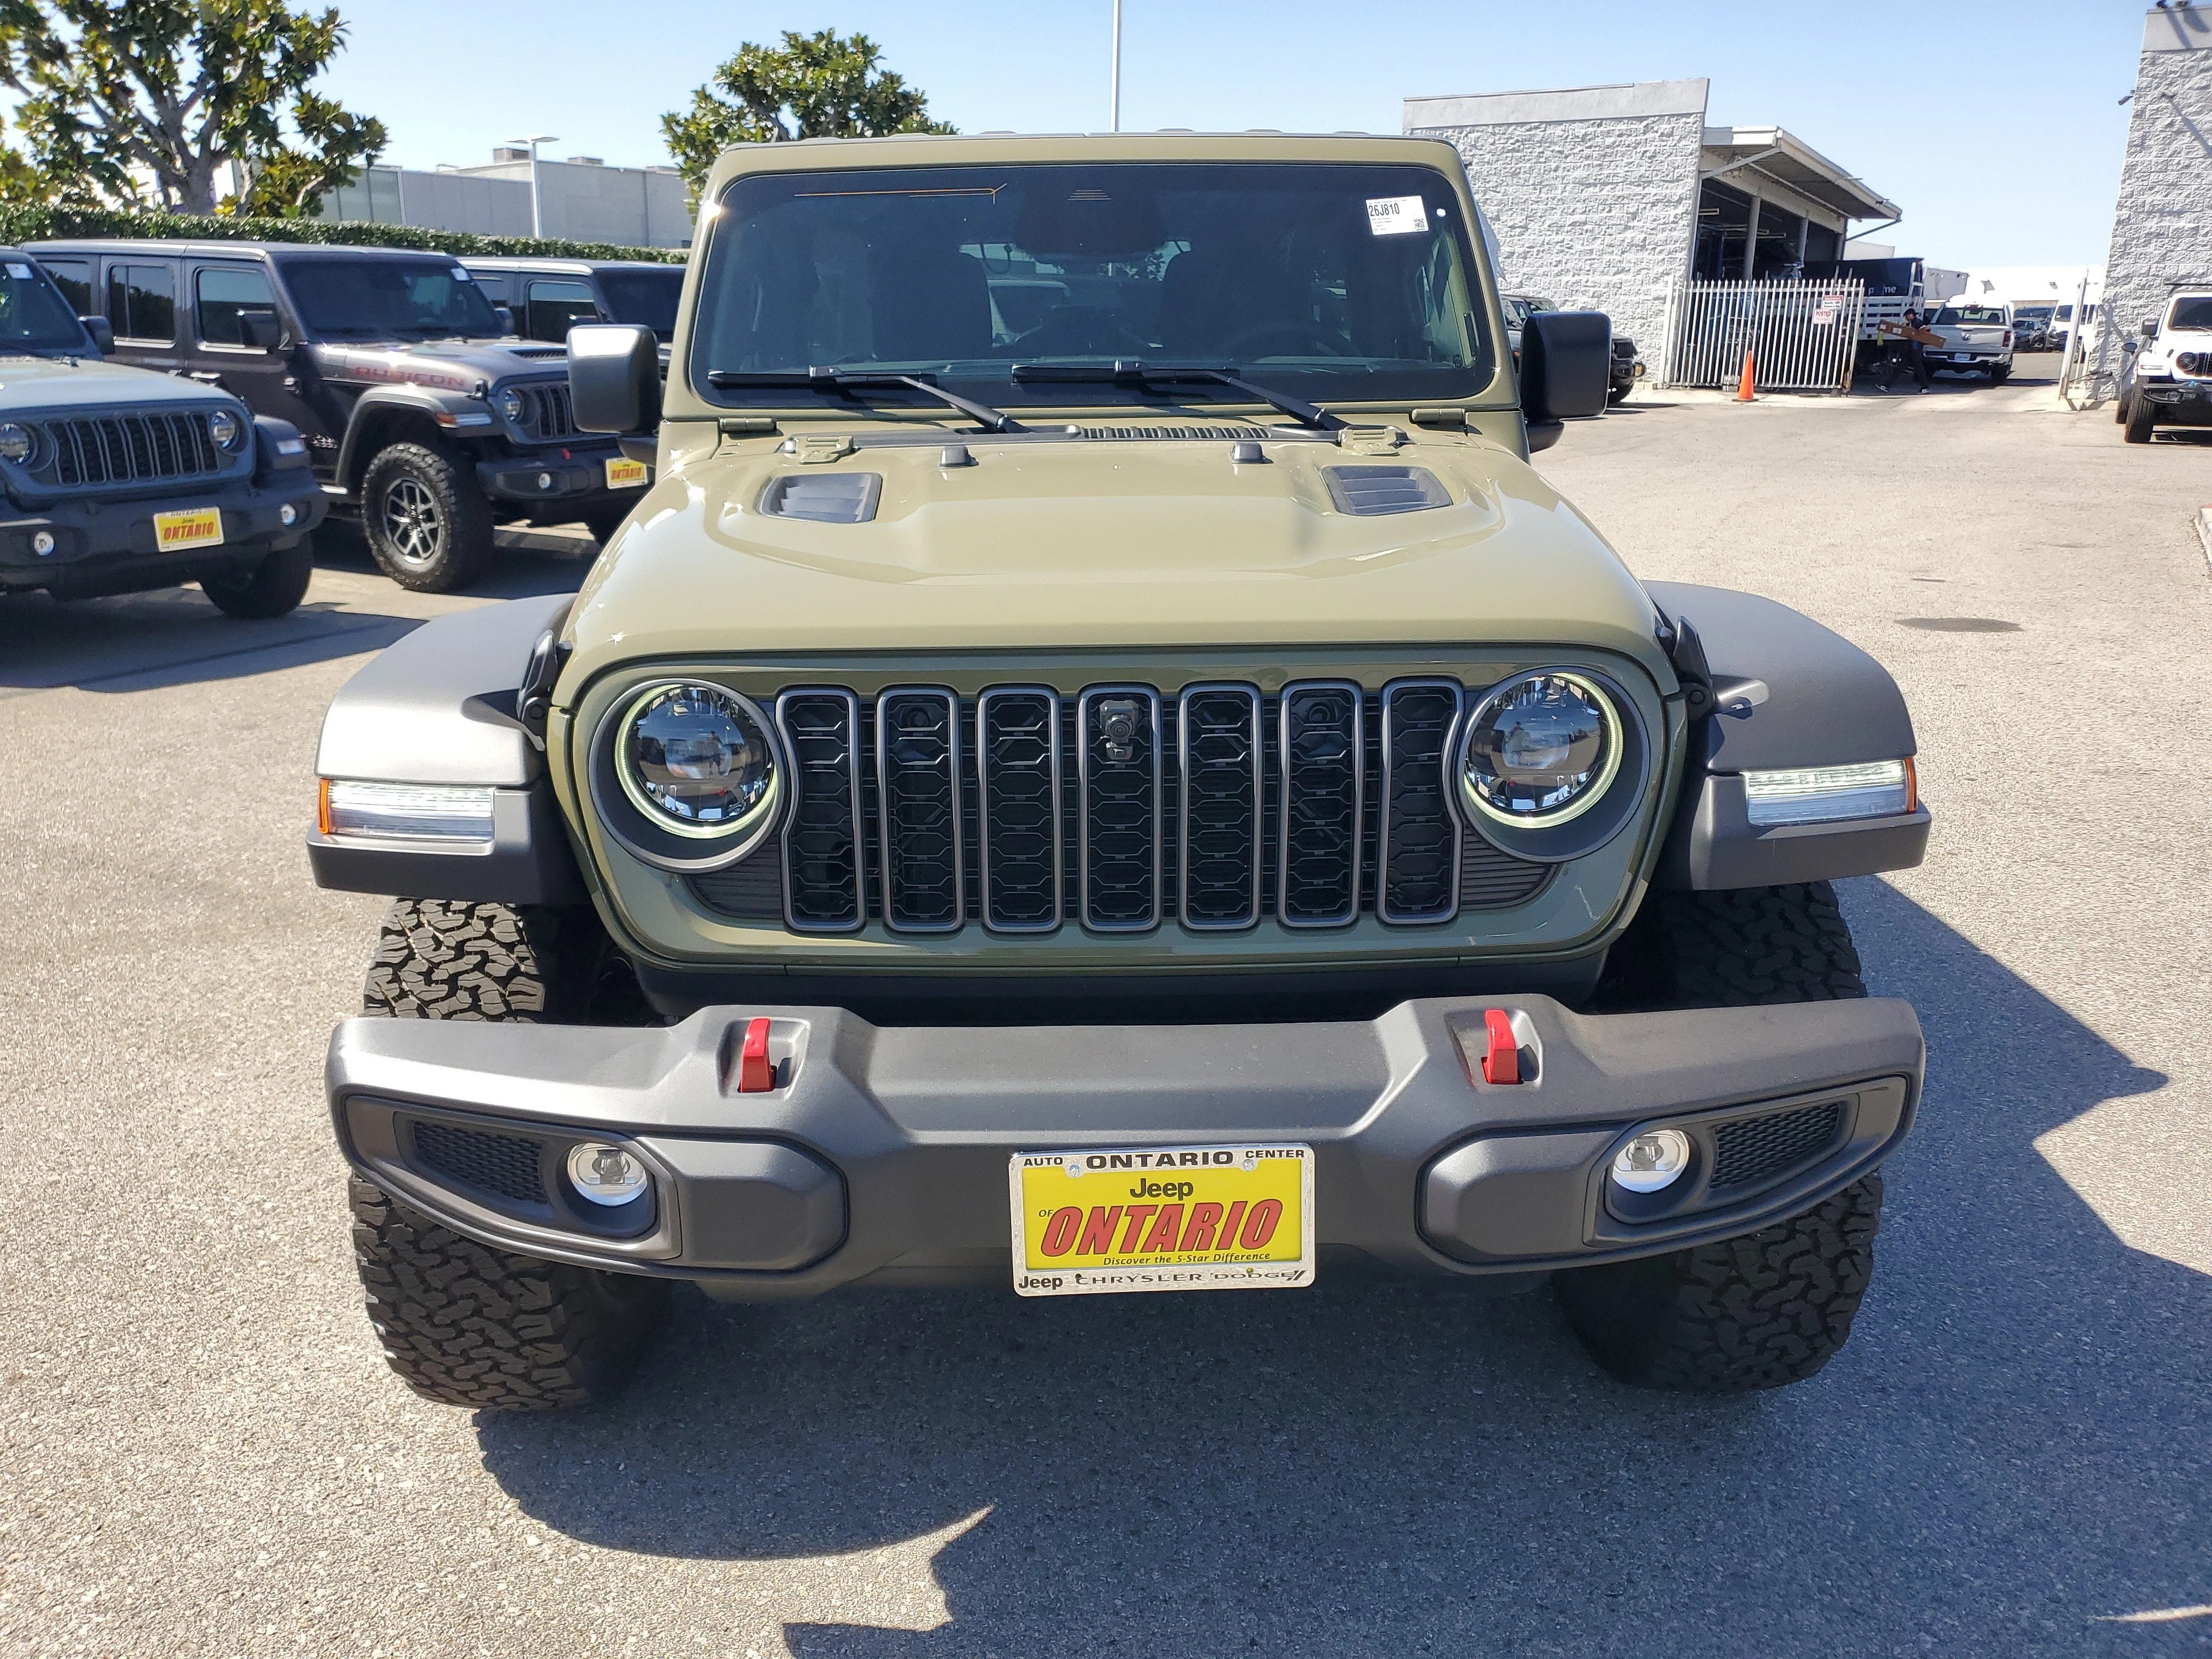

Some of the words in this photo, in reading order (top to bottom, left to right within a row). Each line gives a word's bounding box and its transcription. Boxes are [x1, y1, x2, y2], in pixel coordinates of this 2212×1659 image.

[1369, 203, 1400, 217] 26J810
[1024, 1156, 1063, 1166] AUTO
[1086, 1151, 1233, 1169] ONTARIO
[1245, 1149, 1305, 1159] CENTER
[1130, 1178, 1194, 1201] Jeep
[1039, 1209, 1054, 1217] OF
[1041, 1199, 1283, 1257] ONTARIO
[1103, 1257, 1151, 1266] Discover
[1154, 1255, 1172, 1263] the
[1176, 1254, 1210, 1263] 5-Star
[1213, 1252, 1271, 1264] Difference
[1018, 1276, 1063, 1290] Jeep
[1075, 1273, 1203, 1285] CHRYSLER
